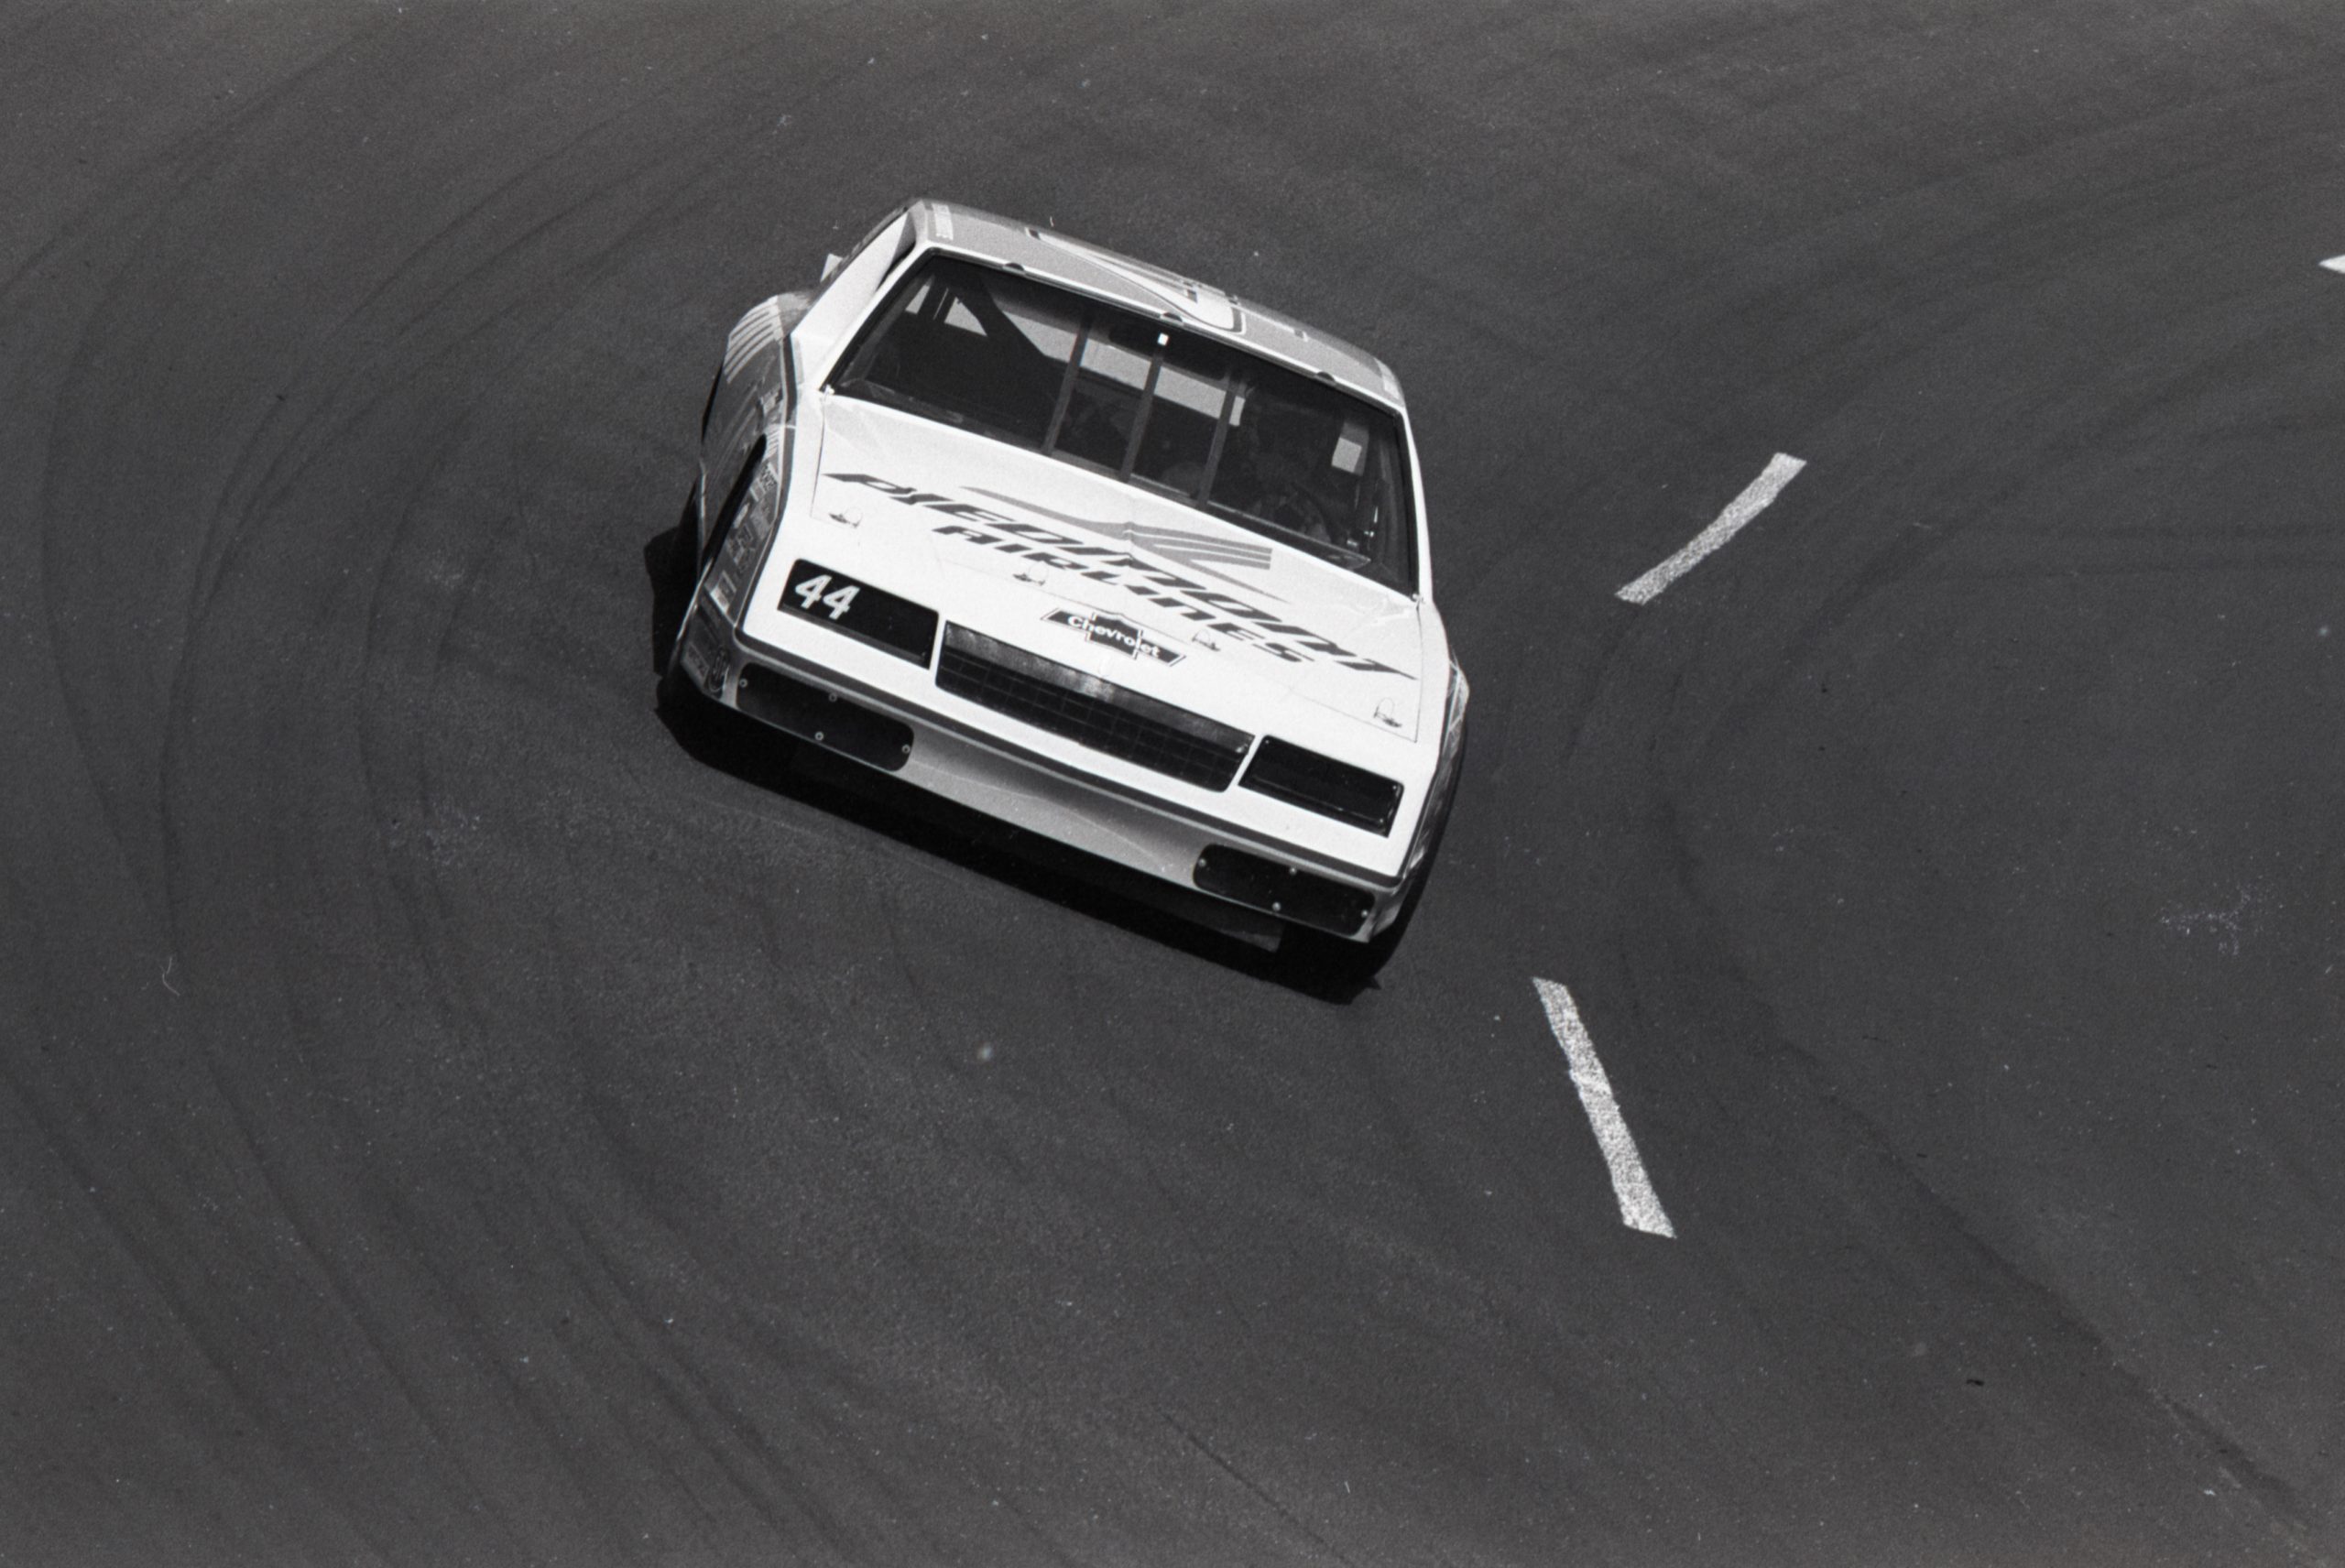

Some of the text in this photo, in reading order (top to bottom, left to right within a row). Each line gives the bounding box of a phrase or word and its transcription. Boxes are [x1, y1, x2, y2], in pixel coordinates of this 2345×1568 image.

[793, 574, 861, 620] 44
[823, 474, 1418, 680] PIEDMONT
[933, 525, 1318, 663] AIRLINES
[1067, 615, 1161, 658] Chevrolet
